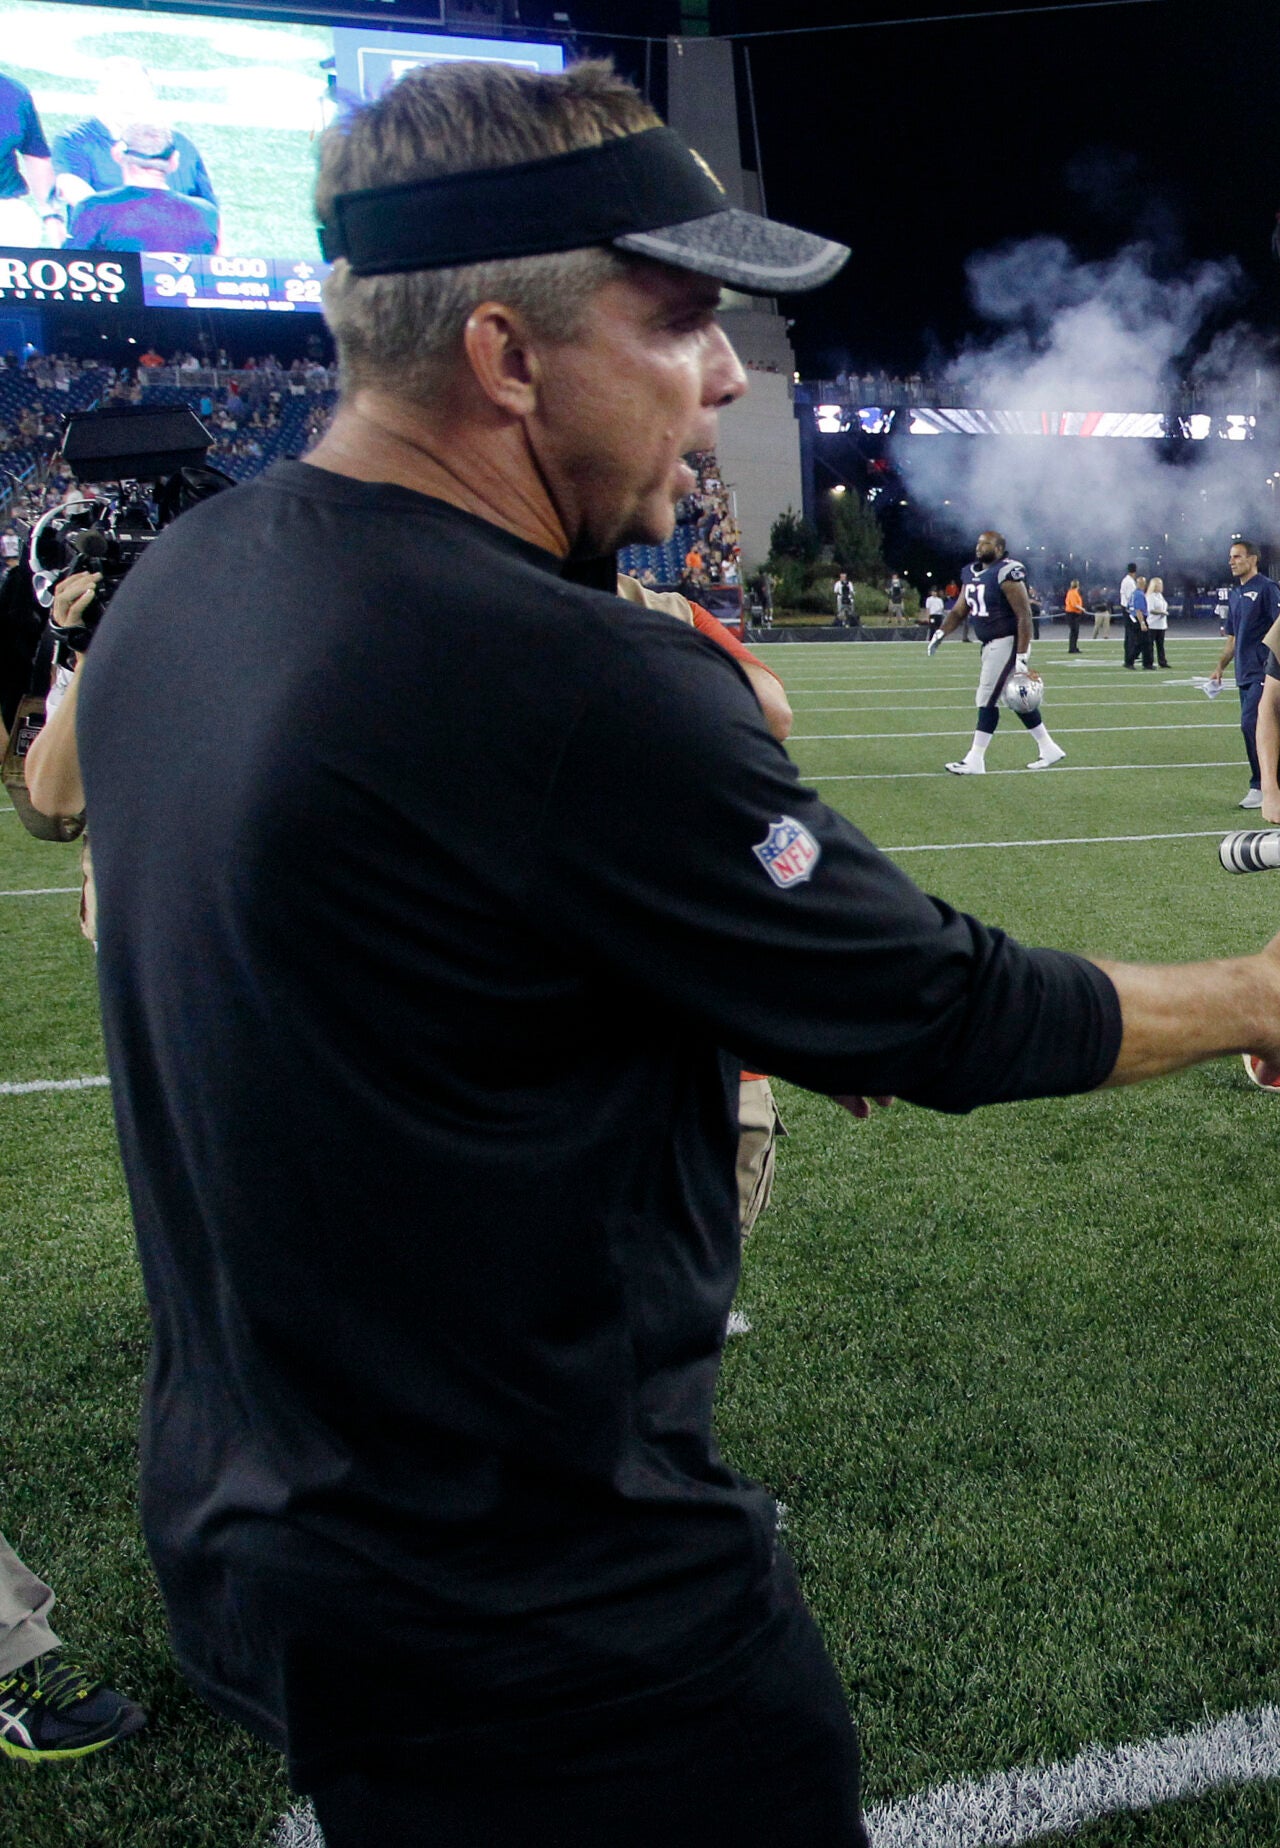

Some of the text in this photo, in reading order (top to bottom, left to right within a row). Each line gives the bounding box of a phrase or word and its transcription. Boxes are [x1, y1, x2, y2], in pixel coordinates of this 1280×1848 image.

[210, 256, 267, 278] 0:00
[155, 274, 197, 297] 34
[285, 279, 322, 303] 22
[965, 584, 989, 616] 61
[772, 840, 815, 880] NFL
